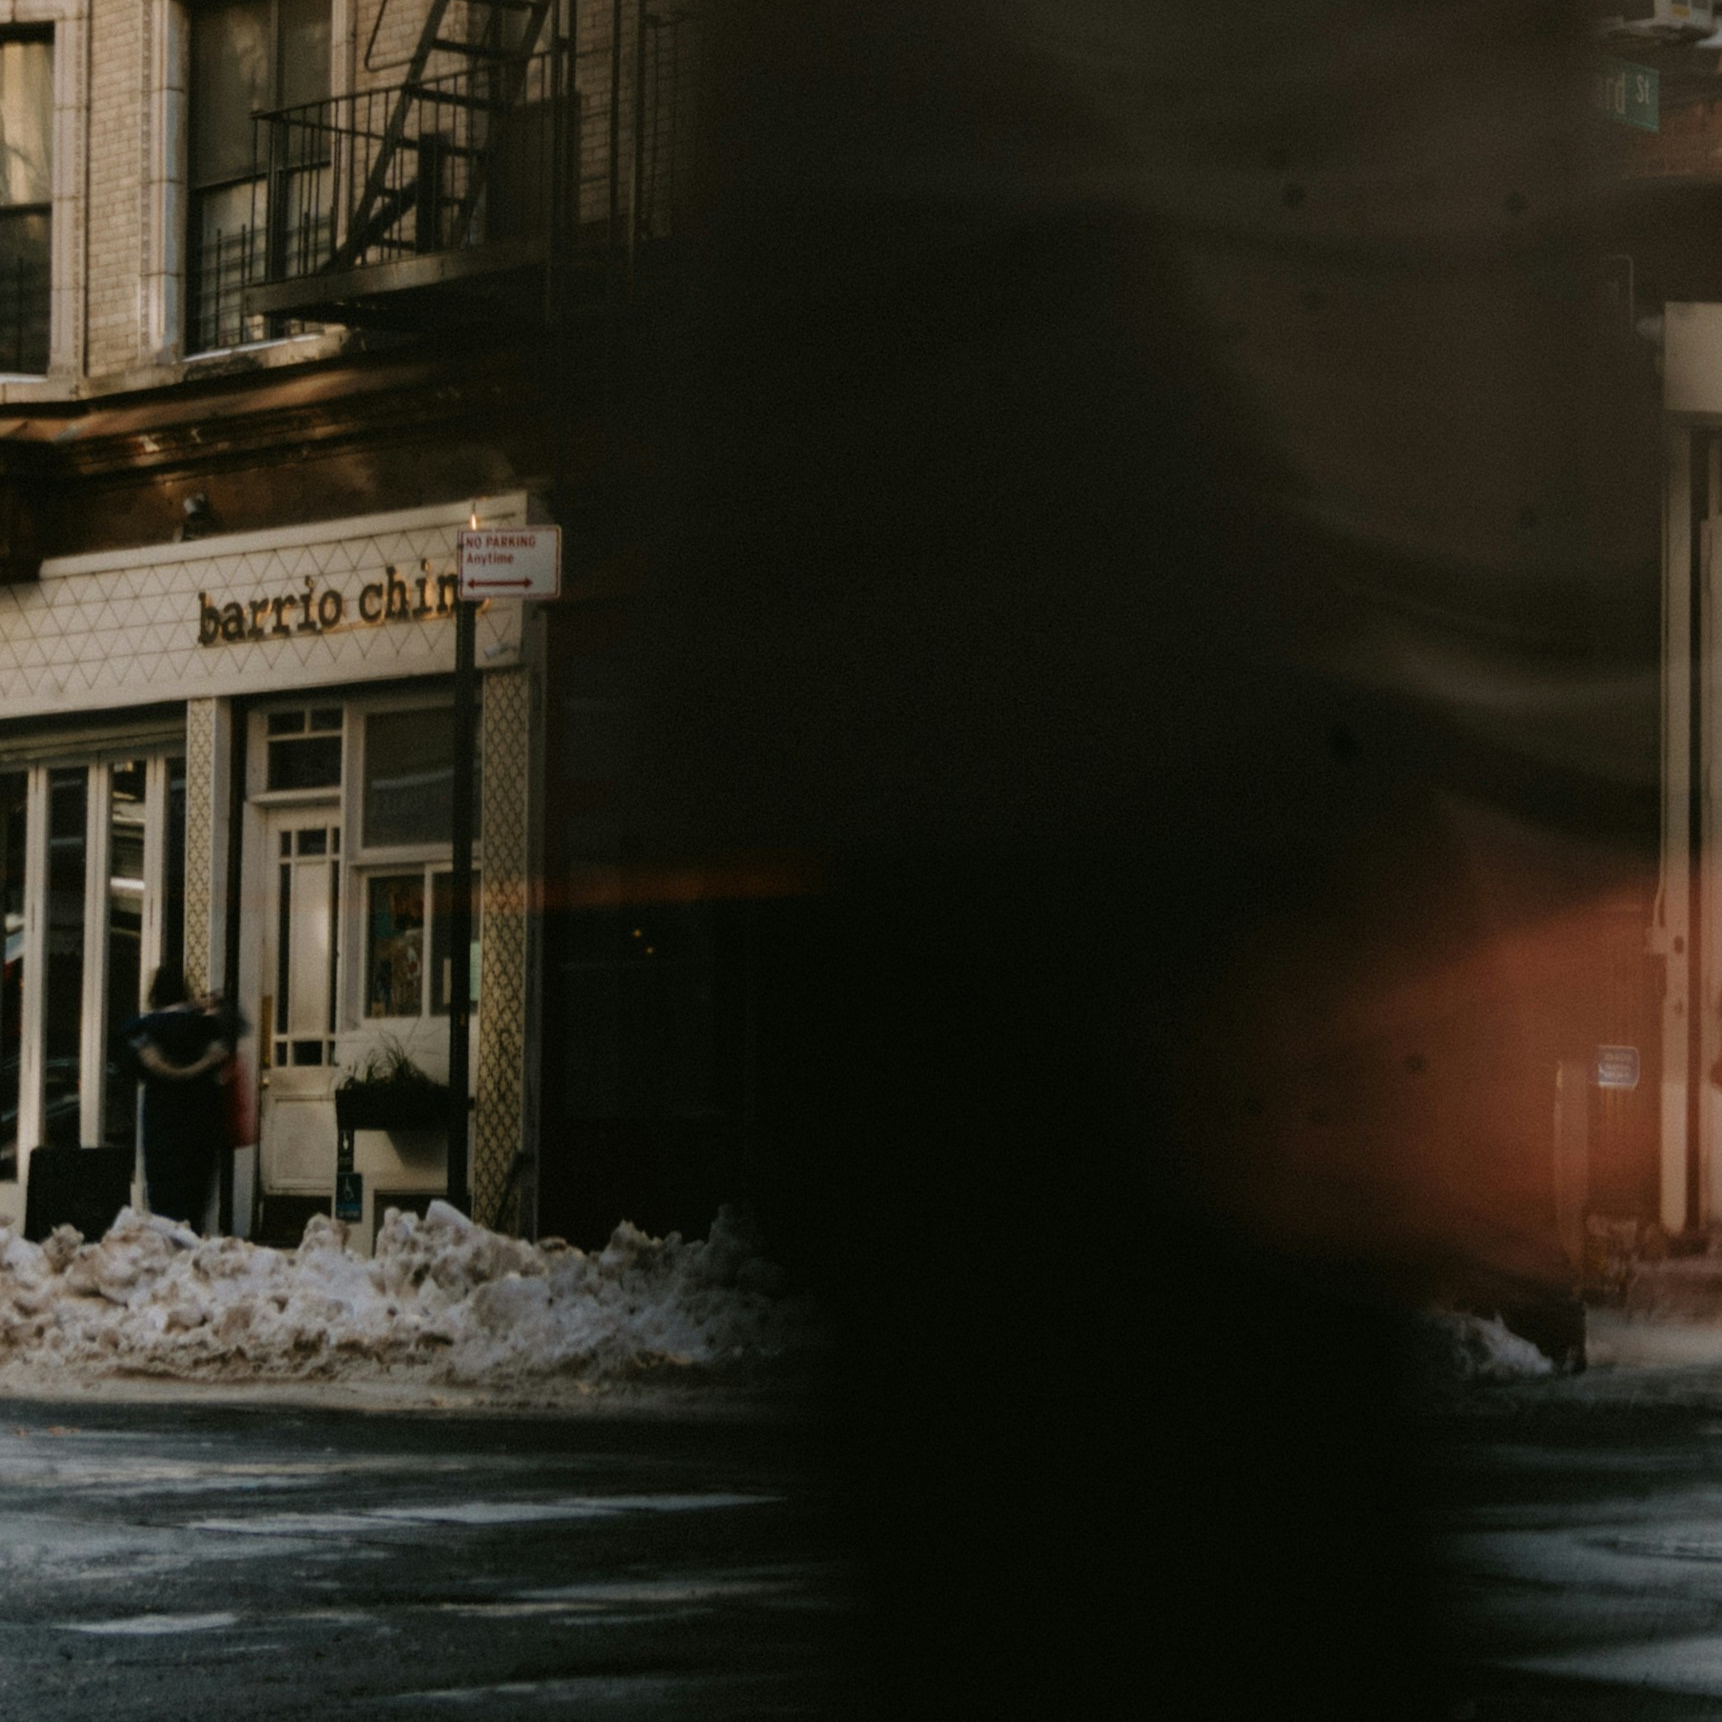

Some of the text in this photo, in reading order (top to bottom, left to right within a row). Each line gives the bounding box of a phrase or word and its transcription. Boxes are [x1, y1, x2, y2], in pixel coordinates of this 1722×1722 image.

[466, 536, 536, 549] NO PARKING
[466, 553, 514, 566] Anytime
[197, 557, 486, 648] barrio chin
